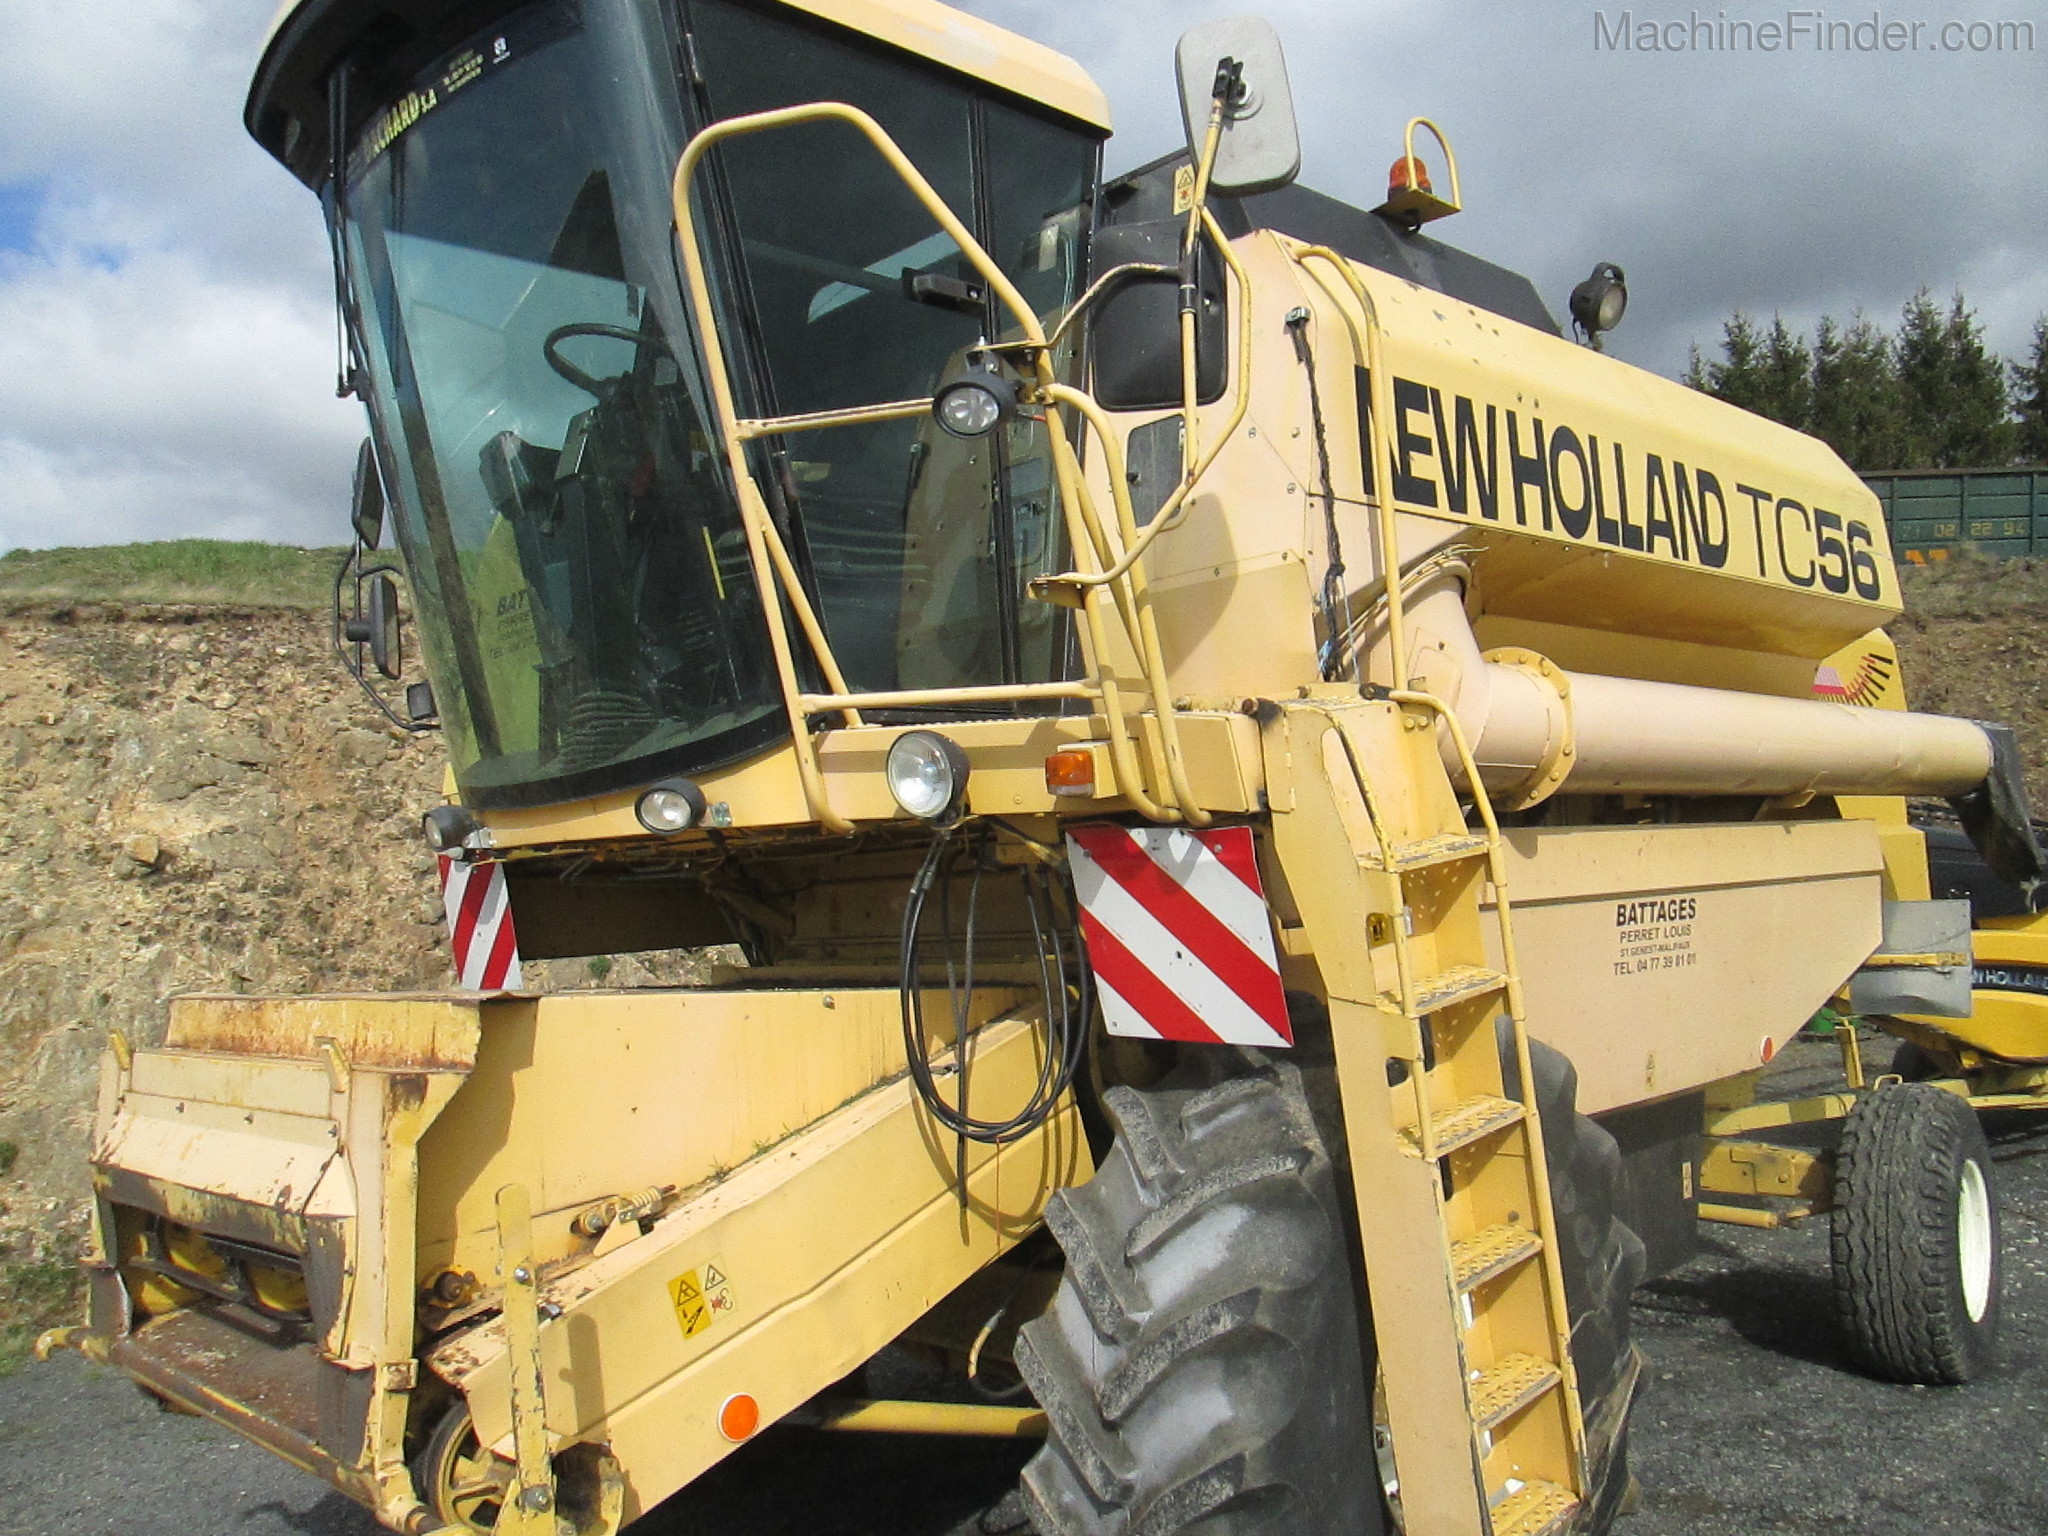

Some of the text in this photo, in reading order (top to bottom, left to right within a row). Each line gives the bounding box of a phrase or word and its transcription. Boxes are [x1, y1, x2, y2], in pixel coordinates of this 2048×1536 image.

[1354, 364, 1881, 601] NEW HOLLAND TC56
[1934, 523, 1957, 538] 02
[1970, 522, 1993, 537] 22
[1616, 898, 1697, 927] BATTAGES
[1620, 924, 1692, 944] PERRET LOUIS
